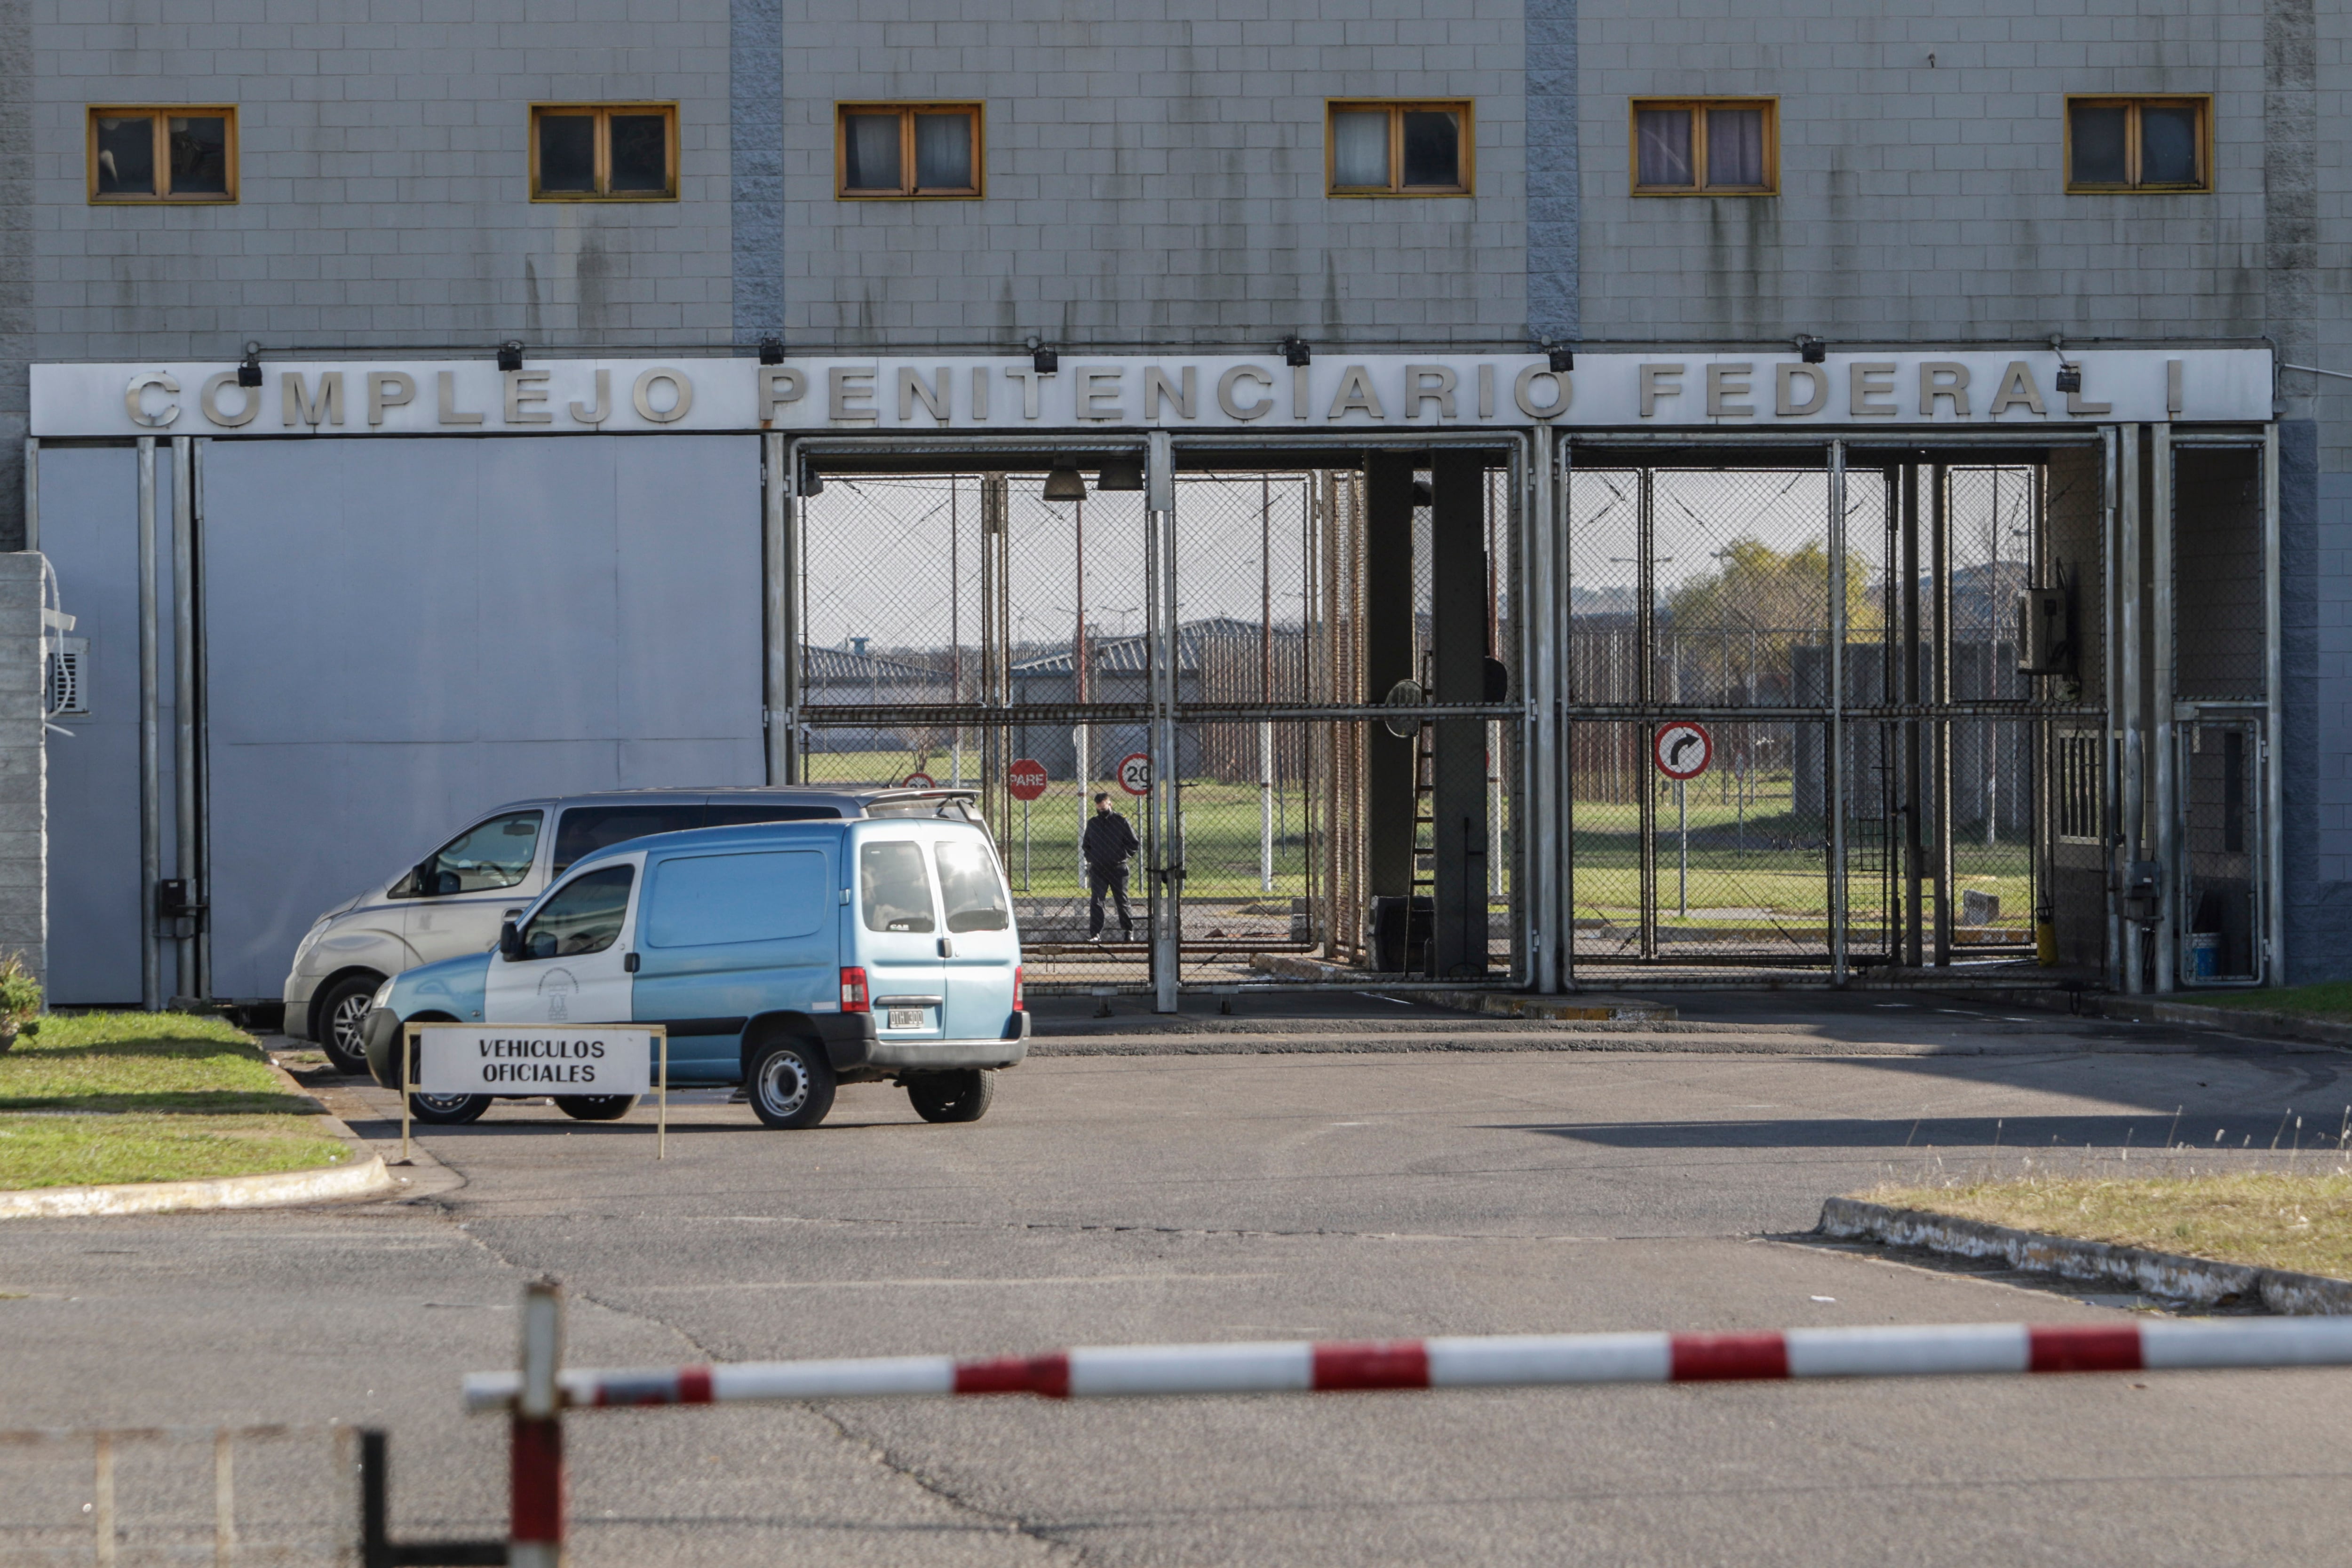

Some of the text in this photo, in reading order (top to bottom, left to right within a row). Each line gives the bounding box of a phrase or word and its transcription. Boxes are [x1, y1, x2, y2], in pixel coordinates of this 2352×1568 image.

[126, 360, 2182, 427] COMPLEJO PENITENCIARIO FEDERAL I
[1010, 774, 1044, 786] PARE
[1127, 766, 1150, 782] 20
[479, 1039, 605, 1058] VEHICULOS
[483, 1063, 595, 1082] OFICIALES
